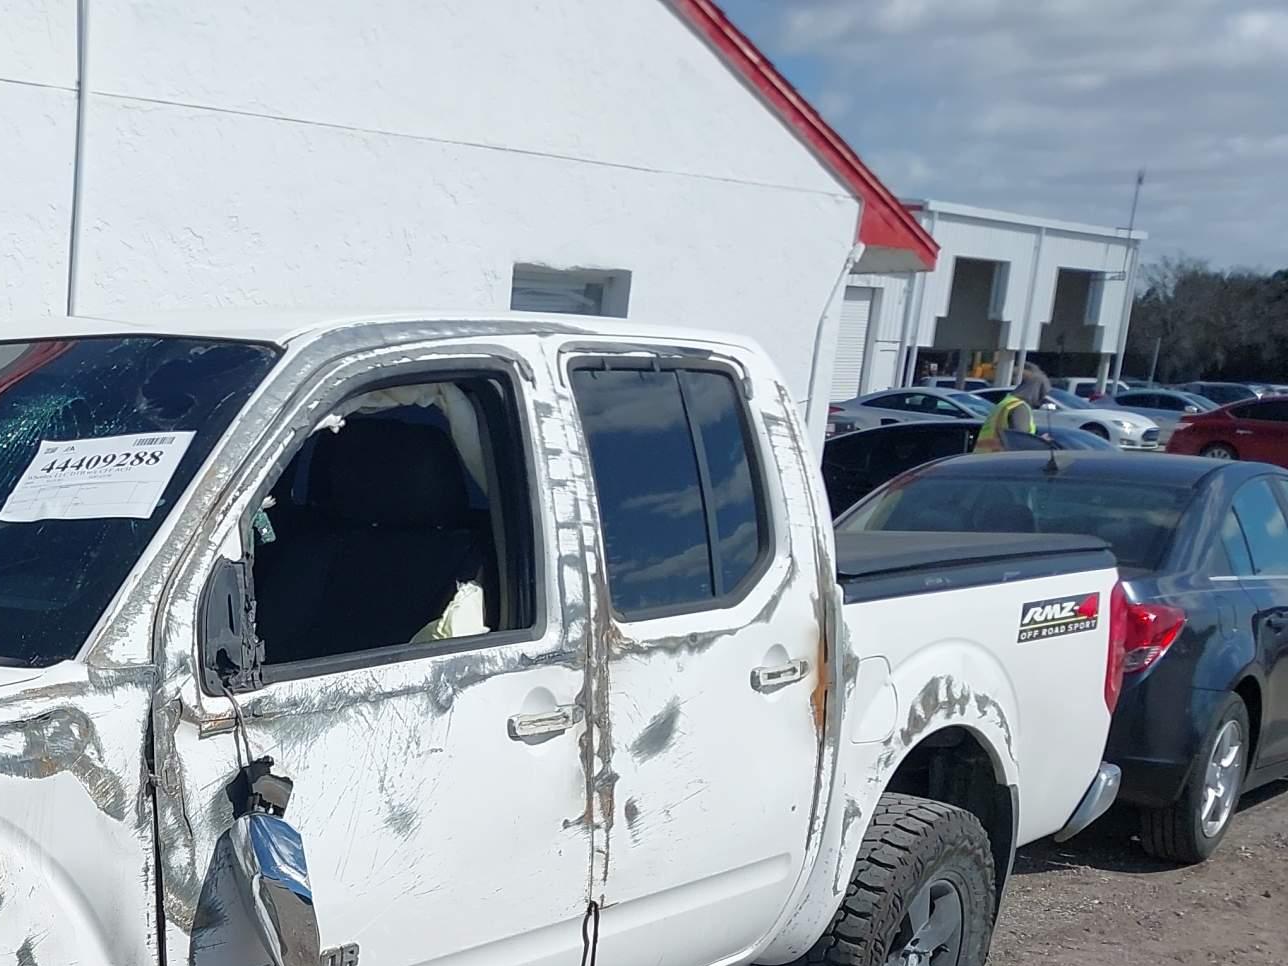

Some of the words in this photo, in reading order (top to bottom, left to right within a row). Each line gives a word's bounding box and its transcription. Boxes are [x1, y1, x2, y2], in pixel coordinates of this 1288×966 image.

[40, 450, 164, 474] 44409288
[1020, 630, 1040, 641] OFF
[1042, 625, 1066, 637] ROAD
[1067, 619, 1097, 632] SPORT
